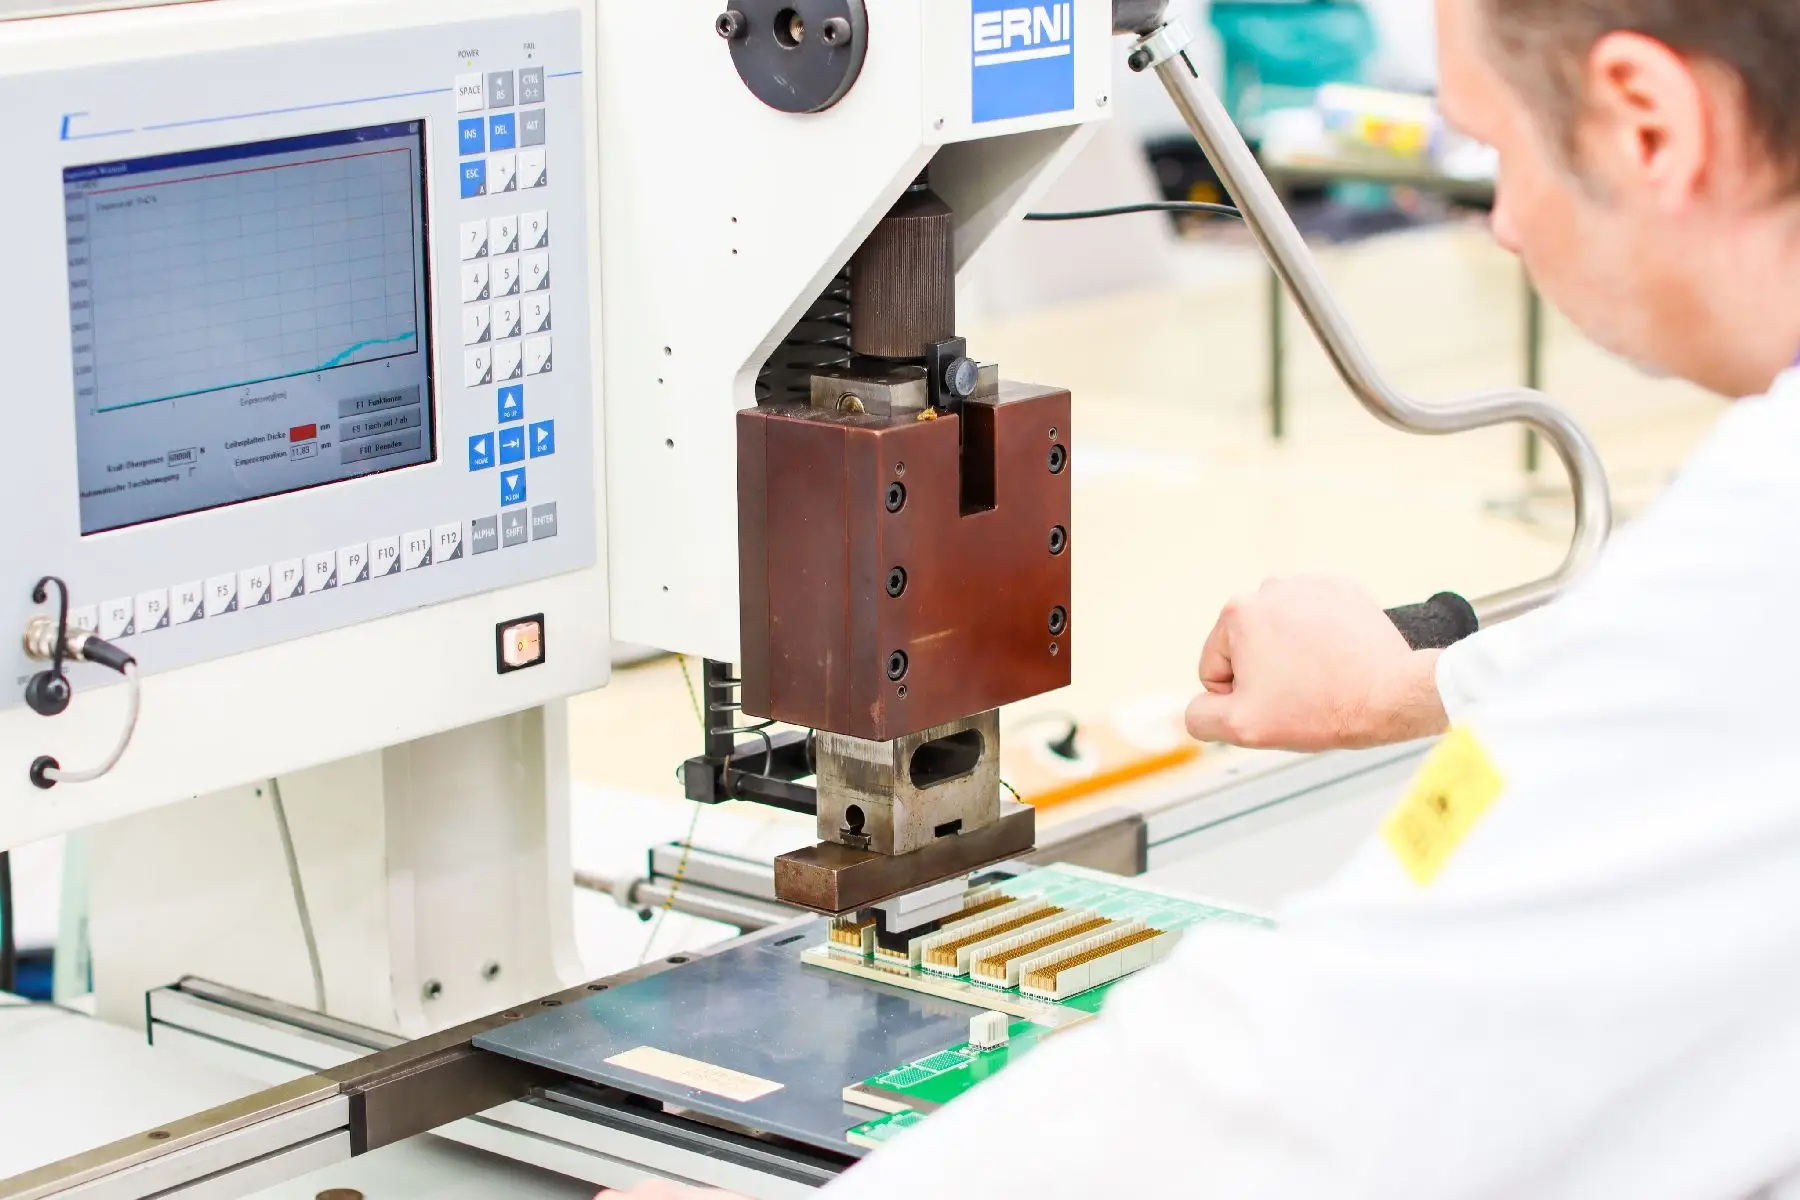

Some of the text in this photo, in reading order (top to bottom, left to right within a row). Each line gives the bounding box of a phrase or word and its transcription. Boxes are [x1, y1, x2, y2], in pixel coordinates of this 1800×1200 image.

[974, 3, 1070, 52] ERNI
[458, 50, 479, 58] POWER
[522, 74, 539, 84] CTRL
[459, 86, 481, 96] SPACE
[496, 90, 505, 99] BS
[495, 125, 507, 135] DEL
[526, 120, 539, 130] ALT
[464, 129, 477, 139] INS
[465, 168, 479, 179] ESC
[267, 432, 286, 441] Dicke
[533, 513, 554, 527] ENTER
[473, 528, 495, 541] ALPHA
[505, 526, 524, 538] SHIFT
[441, 532, 457, 545] F12
[410, 540, 426, 552] F11
[378, 547, 395, 560] F10
[349, 554, 360, 566] F9
[316, 562, 328, 574] F8
[284, 570, 294, 582] F7
[250, 578, 262, 590] F6
[217, 585, 228, 597] F5
[182, 592, 194, 605] F4
[148, 601, 160, 613] F3
[113, 608, 125, 621] F2
